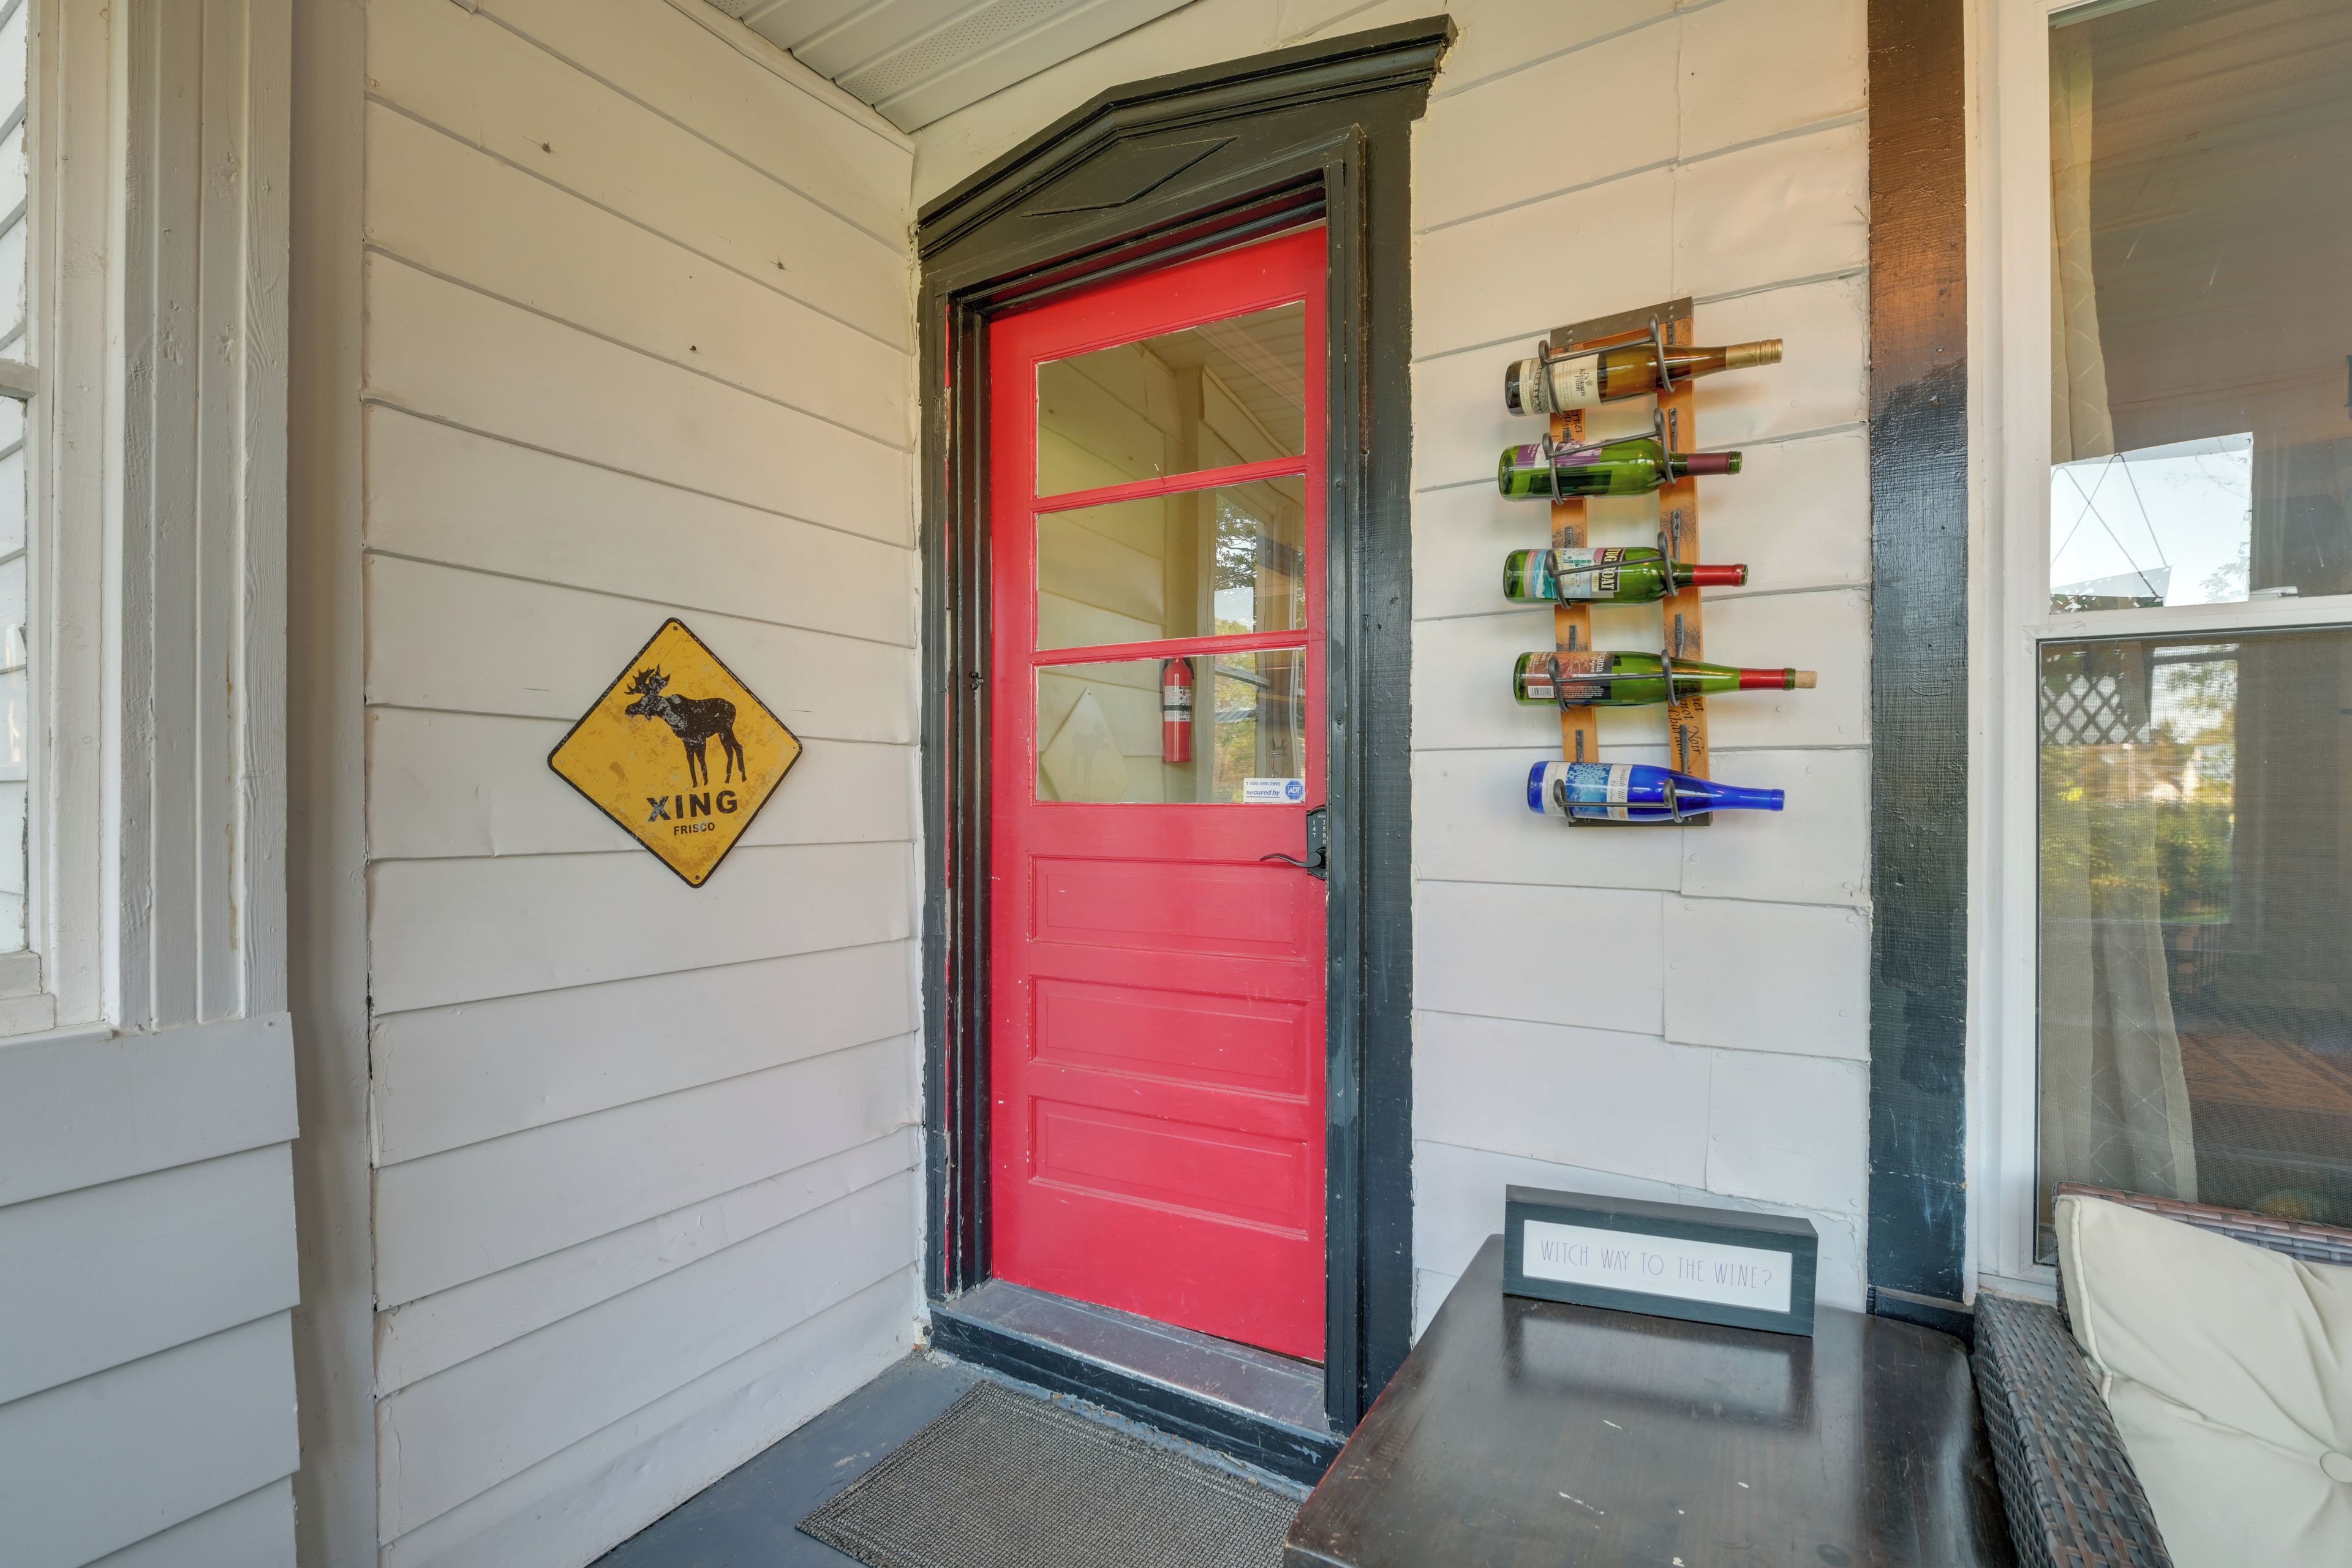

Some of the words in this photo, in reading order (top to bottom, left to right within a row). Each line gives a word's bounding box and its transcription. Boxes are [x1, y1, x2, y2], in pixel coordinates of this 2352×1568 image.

[1605, 548, 1621, 562] TUG
[1597, 652, 1610, 673] ricana
[1679, 699, 1694, 720] inot
[1688, 726, 1704, 754] Noir
[1618, 768, 1629, 787] Swedish
[1618, 788, 1626, 800] Hill
[646, 790, 738, 823] XING
[673, 822, 715, 836] FRISCO
[1540, 1238, 1589, 1266] WITCH
[1600, 1246, 1630, 1272] WAY
[1641, 1253, 1664, 1276] TO
[1678, 1257, 1705, 1282] THE
[1714, 1262, 1772, 1289] WINE?
